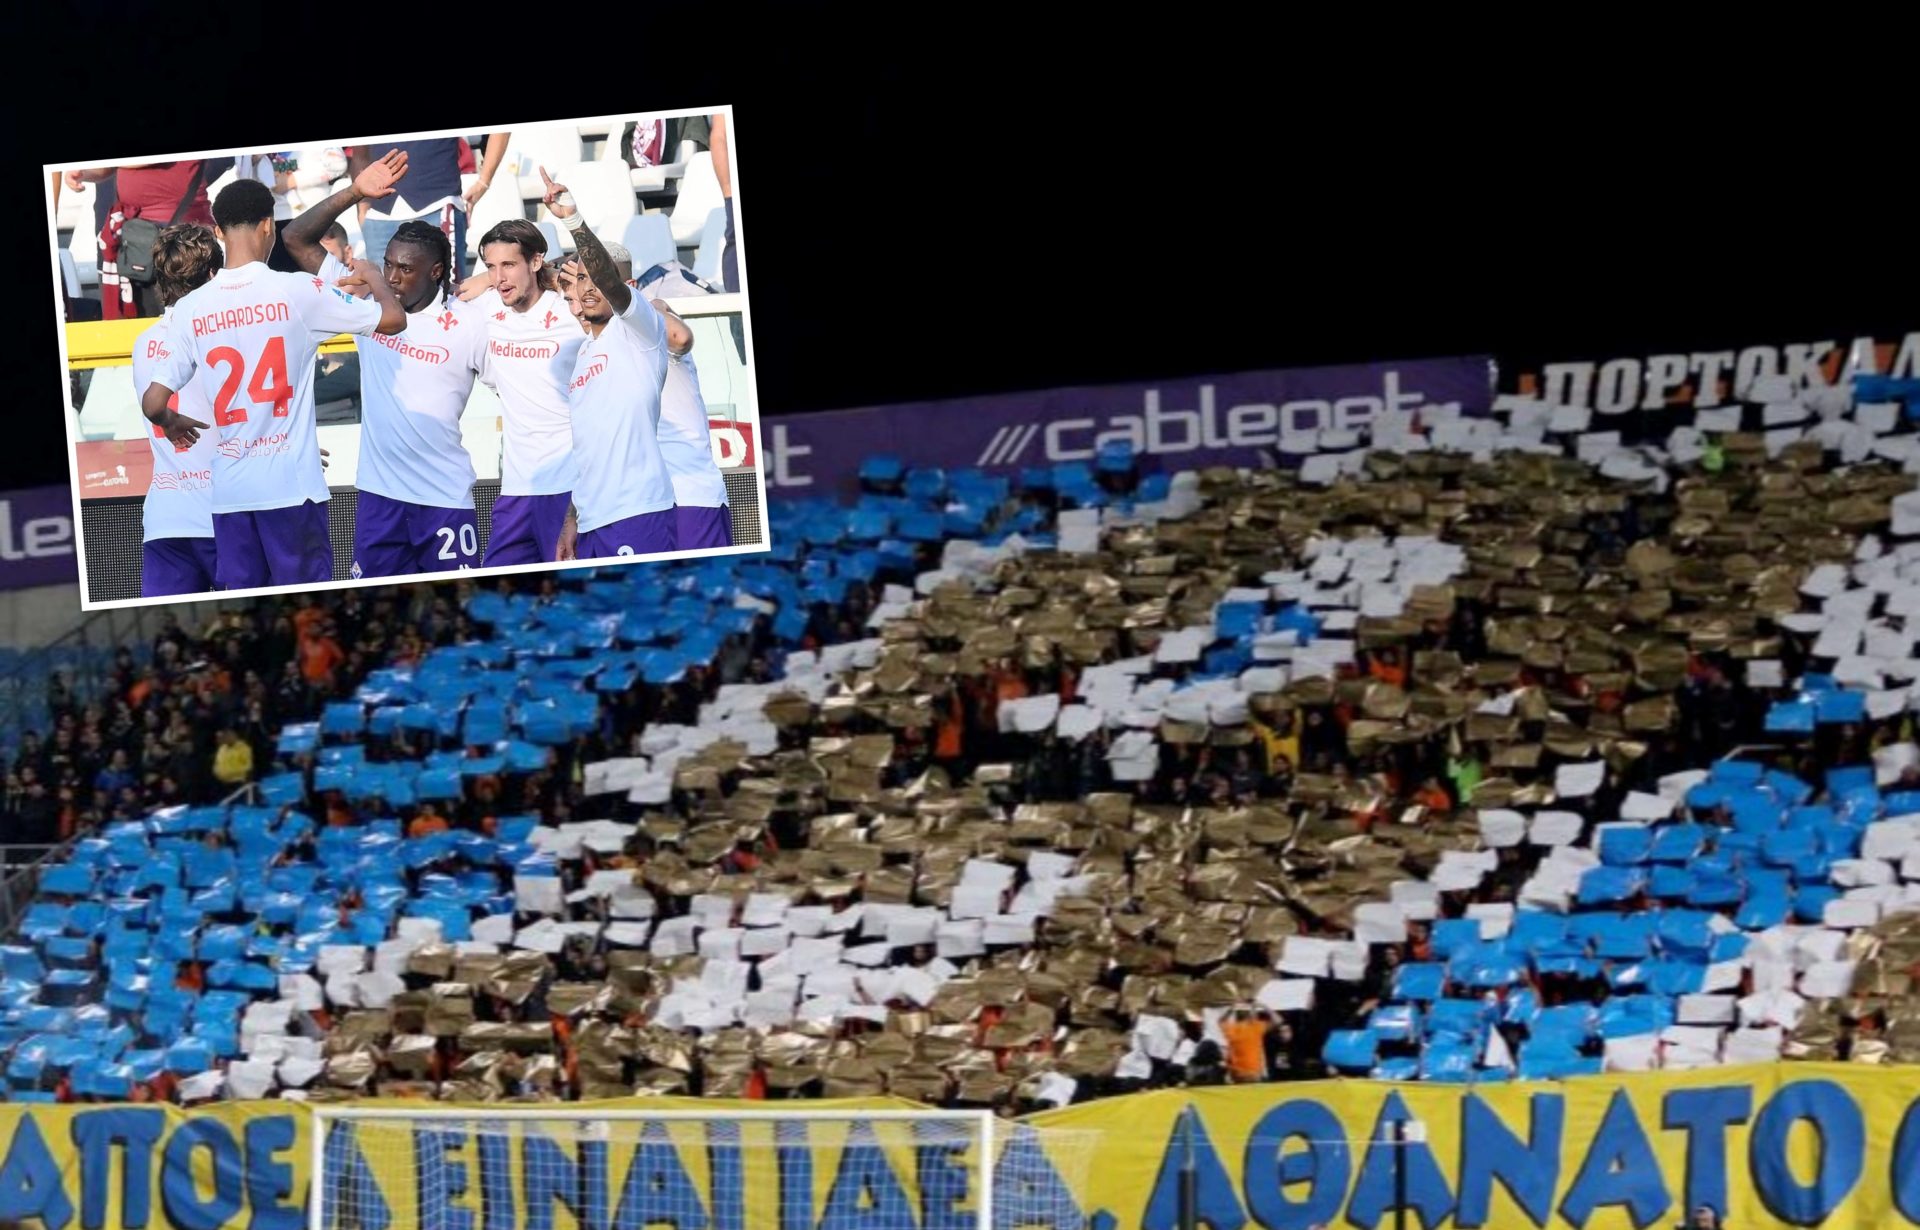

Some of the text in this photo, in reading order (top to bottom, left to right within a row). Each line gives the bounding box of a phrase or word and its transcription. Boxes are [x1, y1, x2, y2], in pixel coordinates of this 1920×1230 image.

[192, 302, 289, 337] RICHARDSON
[490, 340, 550, 359] Mediacom
[205, 336, 294, 427] 24
[436, 523, 478, 560] 20
